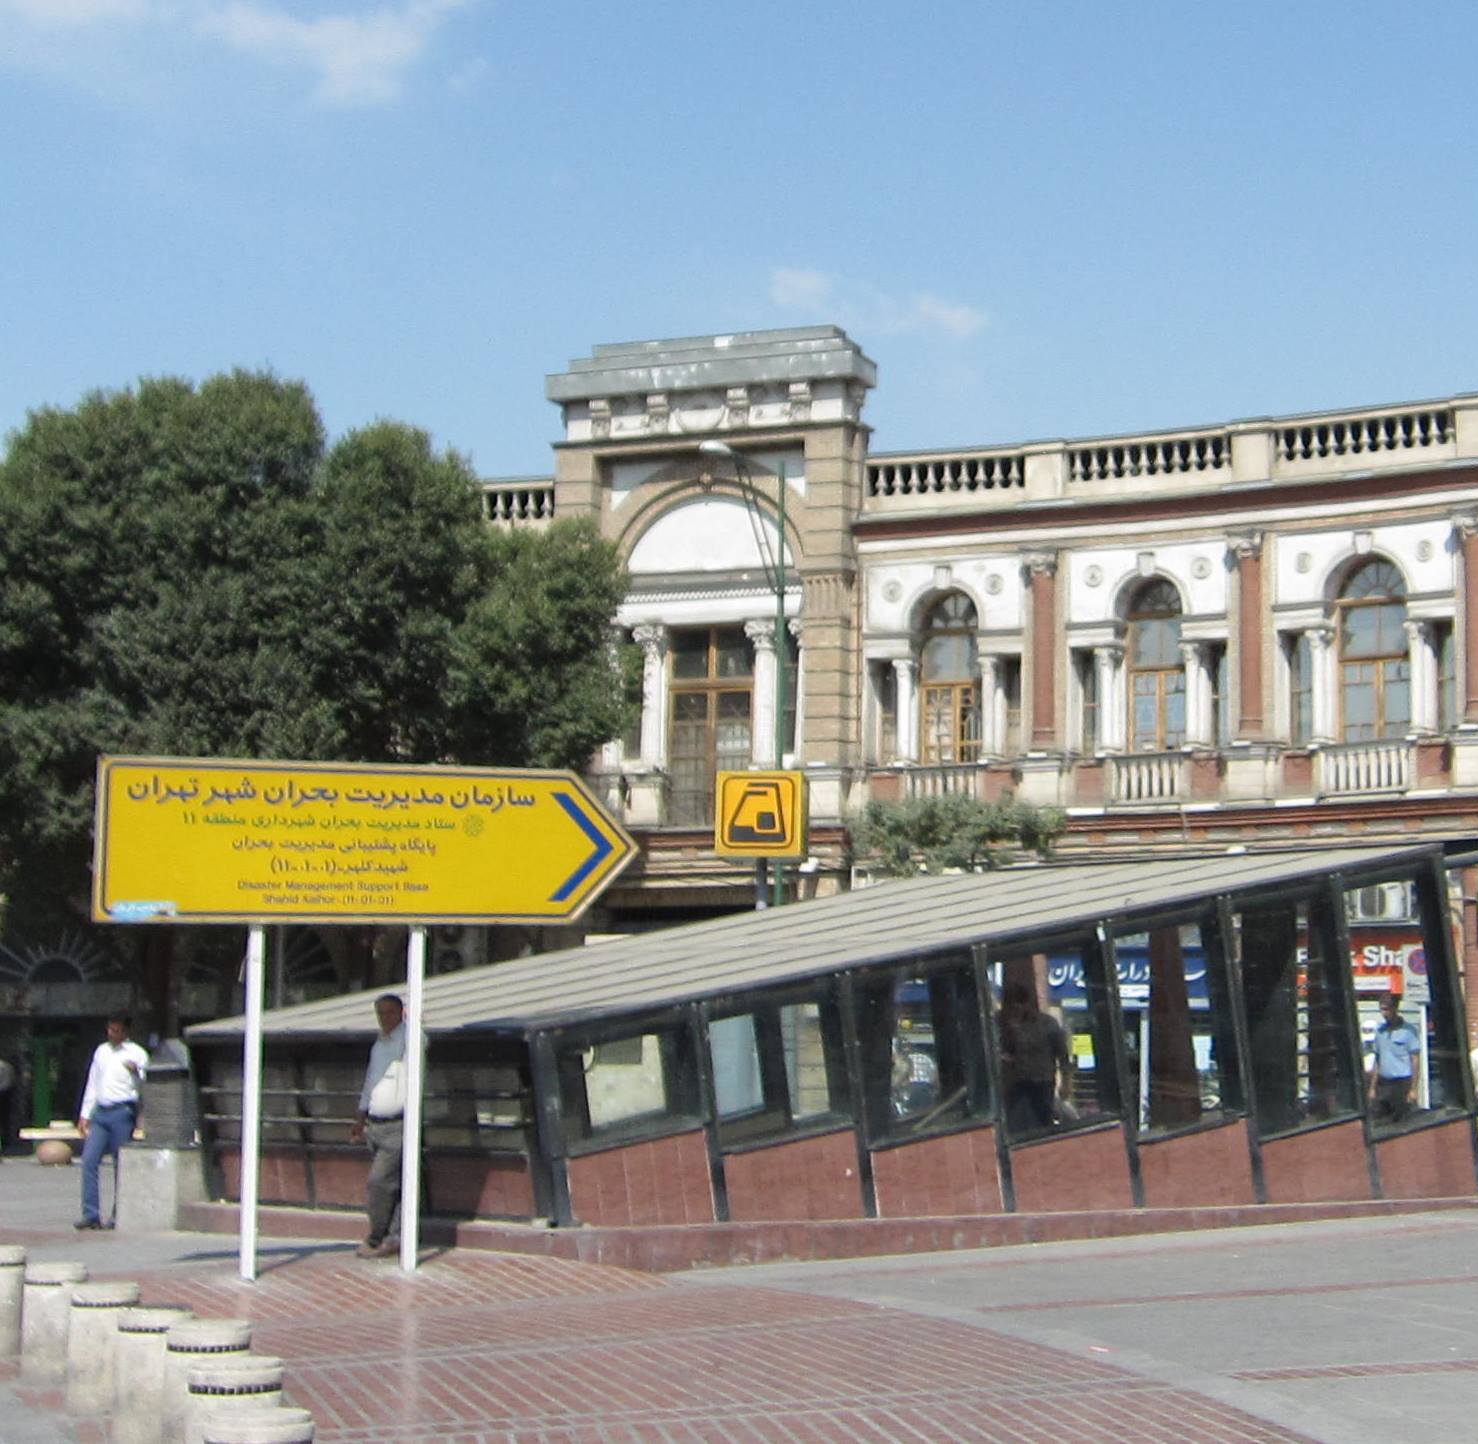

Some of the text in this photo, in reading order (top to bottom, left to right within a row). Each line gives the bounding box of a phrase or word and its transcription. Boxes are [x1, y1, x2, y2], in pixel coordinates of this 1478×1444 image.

[127, 775, 536, 813] سازمان مدیریت بحران شهر تهران
[202, 813, 246, 826] منطقه
[251, 813, 316, 829] شهرداری
[319, 815, 361, 829] بحران
[366, 818, 420, 832] مدیریت
[424, 817, 456, 830] ستاد
[231, 836, 436, 856] پایگاه پشتیبانی مدیریت بحران
[285, 880, 353, 892] Management
[357, 880, 399, 893] Support
